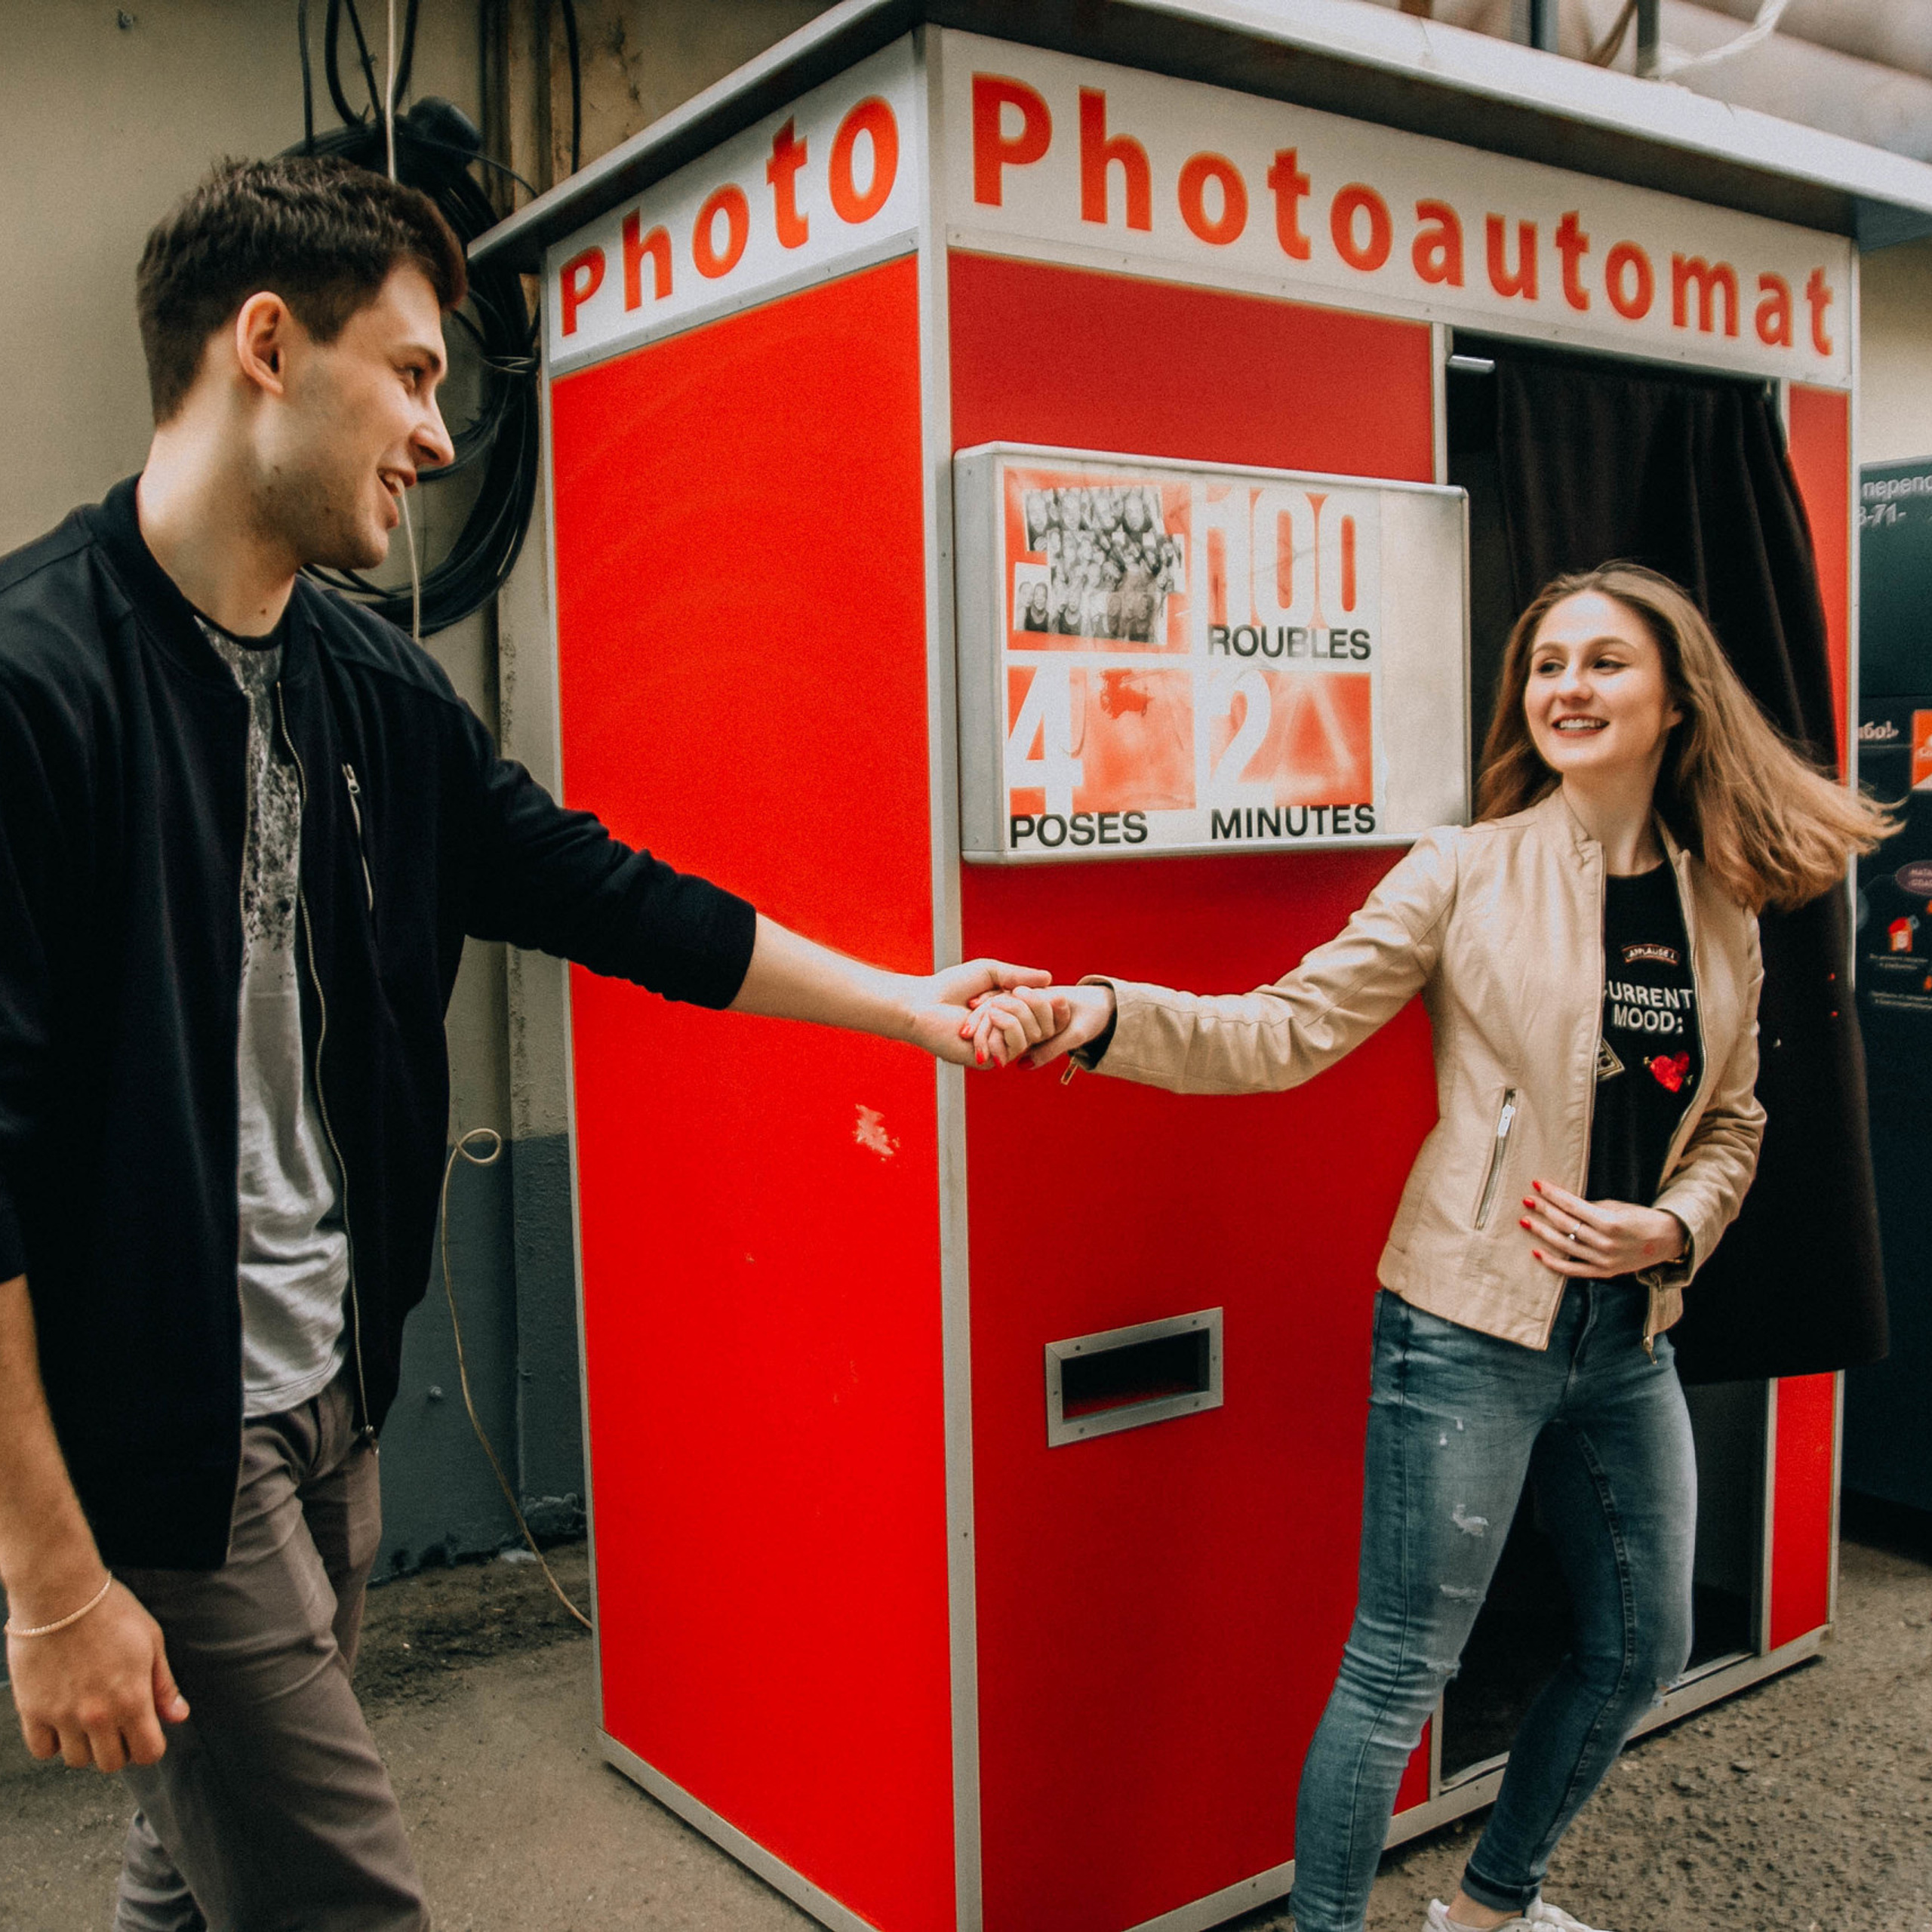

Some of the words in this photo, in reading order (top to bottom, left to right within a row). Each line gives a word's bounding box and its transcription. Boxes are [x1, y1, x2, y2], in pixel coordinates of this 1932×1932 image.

[560, 94, 900, 337] Photo
[971, 70, 1834, 357] Photoautomat
[1205, 485, 1374, 628] 100
[1208, 624, 1371, 660] ROUBLES
[1008, 666, 1082, 814] 4
[1208, 669, 1275, 808] 2
[1010, 811, 1148, 848] POSES
[1211, 804, 1376, 840] MINUTES
[1603, 980, 1694, 1009] URRENT
[1613, 1004, 1684, 1033] MOOD:
